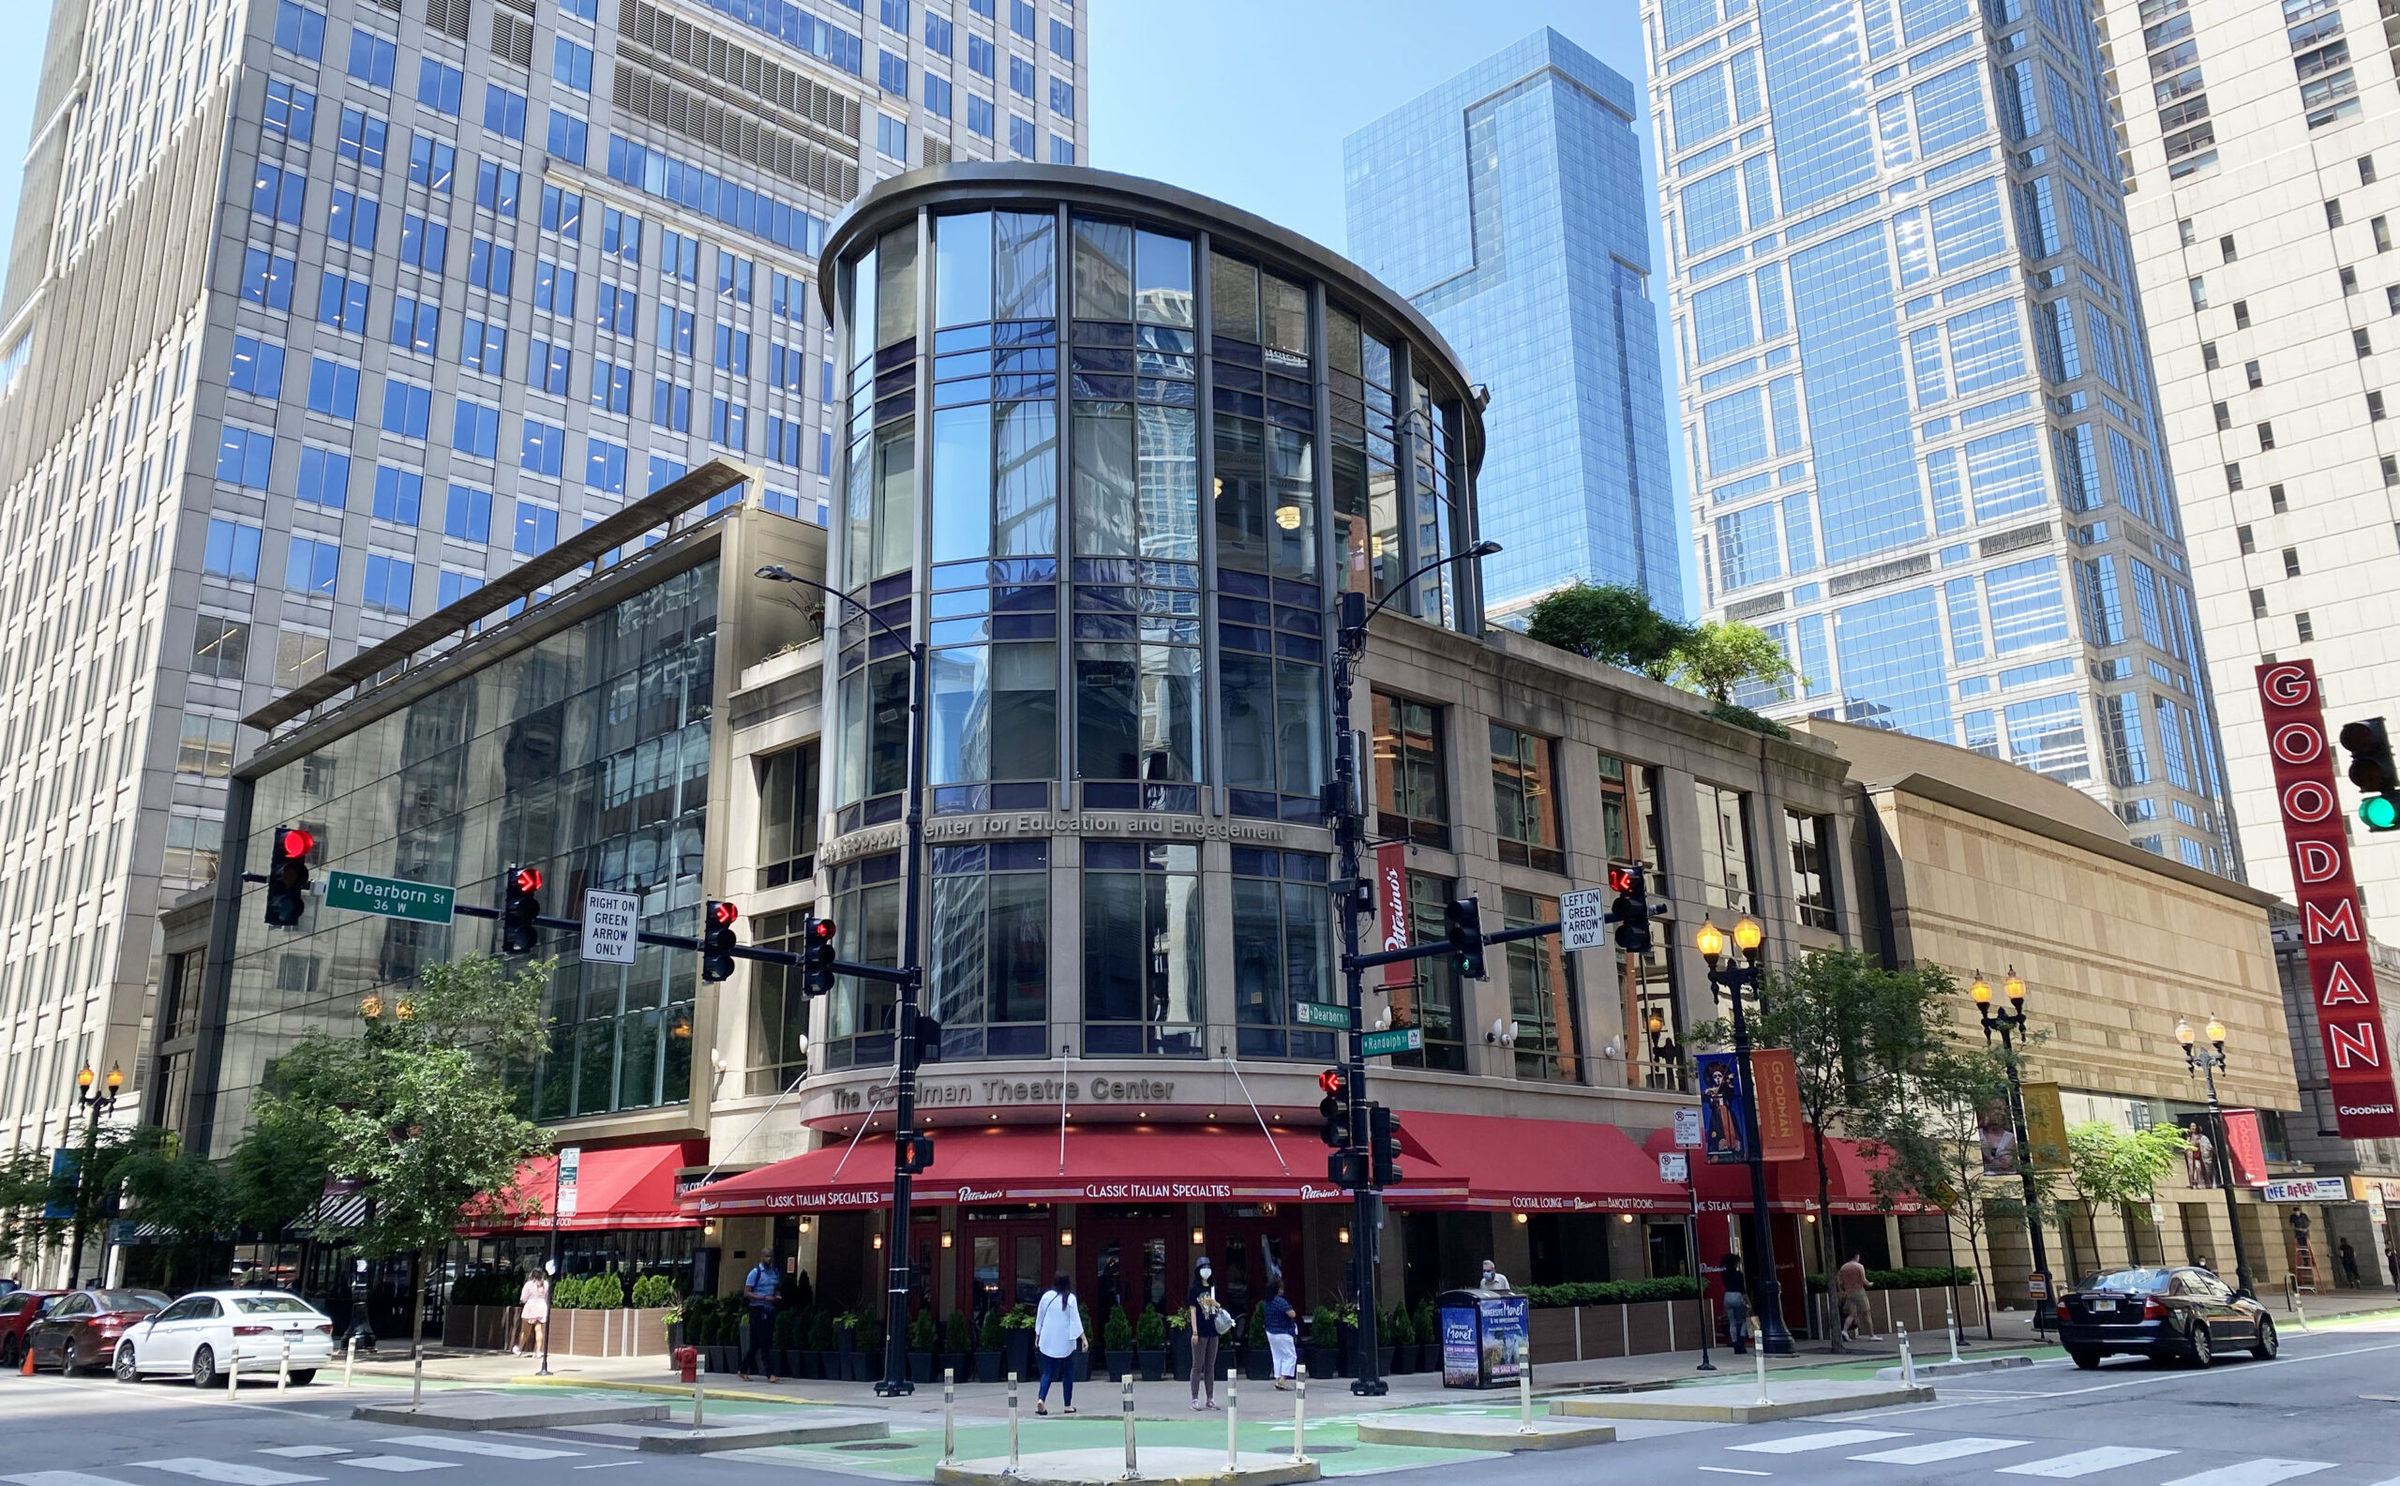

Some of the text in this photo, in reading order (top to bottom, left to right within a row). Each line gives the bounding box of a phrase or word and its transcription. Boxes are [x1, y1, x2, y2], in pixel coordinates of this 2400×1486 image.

[923, 815, 1285, 841] enter for Education and Engagement
[2262, 665, 2380, 1069] GOODMAN
[337, 879, 445, 904] N Dearborn St
[1563, 891, 1599, 907] LEFT ON
[373, 900, 407, 913] 36 W
[589, 897, 635, 912] RIGHT ON
[595, 912, 628, 926] GREEN
[1568, 905, 1597, 920] GREEN
[1569, 919, 1599, 932] ARROW
[592, 928, 628, 942] ARROW
[1573, 932, 1595, 945] ONLY
[595, 943, 623, 956] ONLY
[1313, 1007, 1344, 1023] Dearborn
[1368, 1034, 1401, 1050] Randolph
[832, 1078, 1175, 1110] The Godman Theatre Center
[1771, 1060, 1793, 1138] GOODMAN
[2339, 1104, 2394, 1116] GOODMAN
[958, 1186, 1005, 1202] Petterino's
[1086, 1184, 1231, 1198] CLASSIC ITALIAN SPECIALTIES
[766, 1191, 879, 1208] CLASSIC ITALIAN SPECIALTIES
[1512, 1196, 1562, 1209] COCKTAIL LOUNGE
[1607, 1197, 1654, 1209] BANQUET ROOMS
[1707, 1200, 1732, 1211] STEAK
[1502, 1301, 1525, 1317] Monet
[1446, 1327, 1474, 1341] Monet
